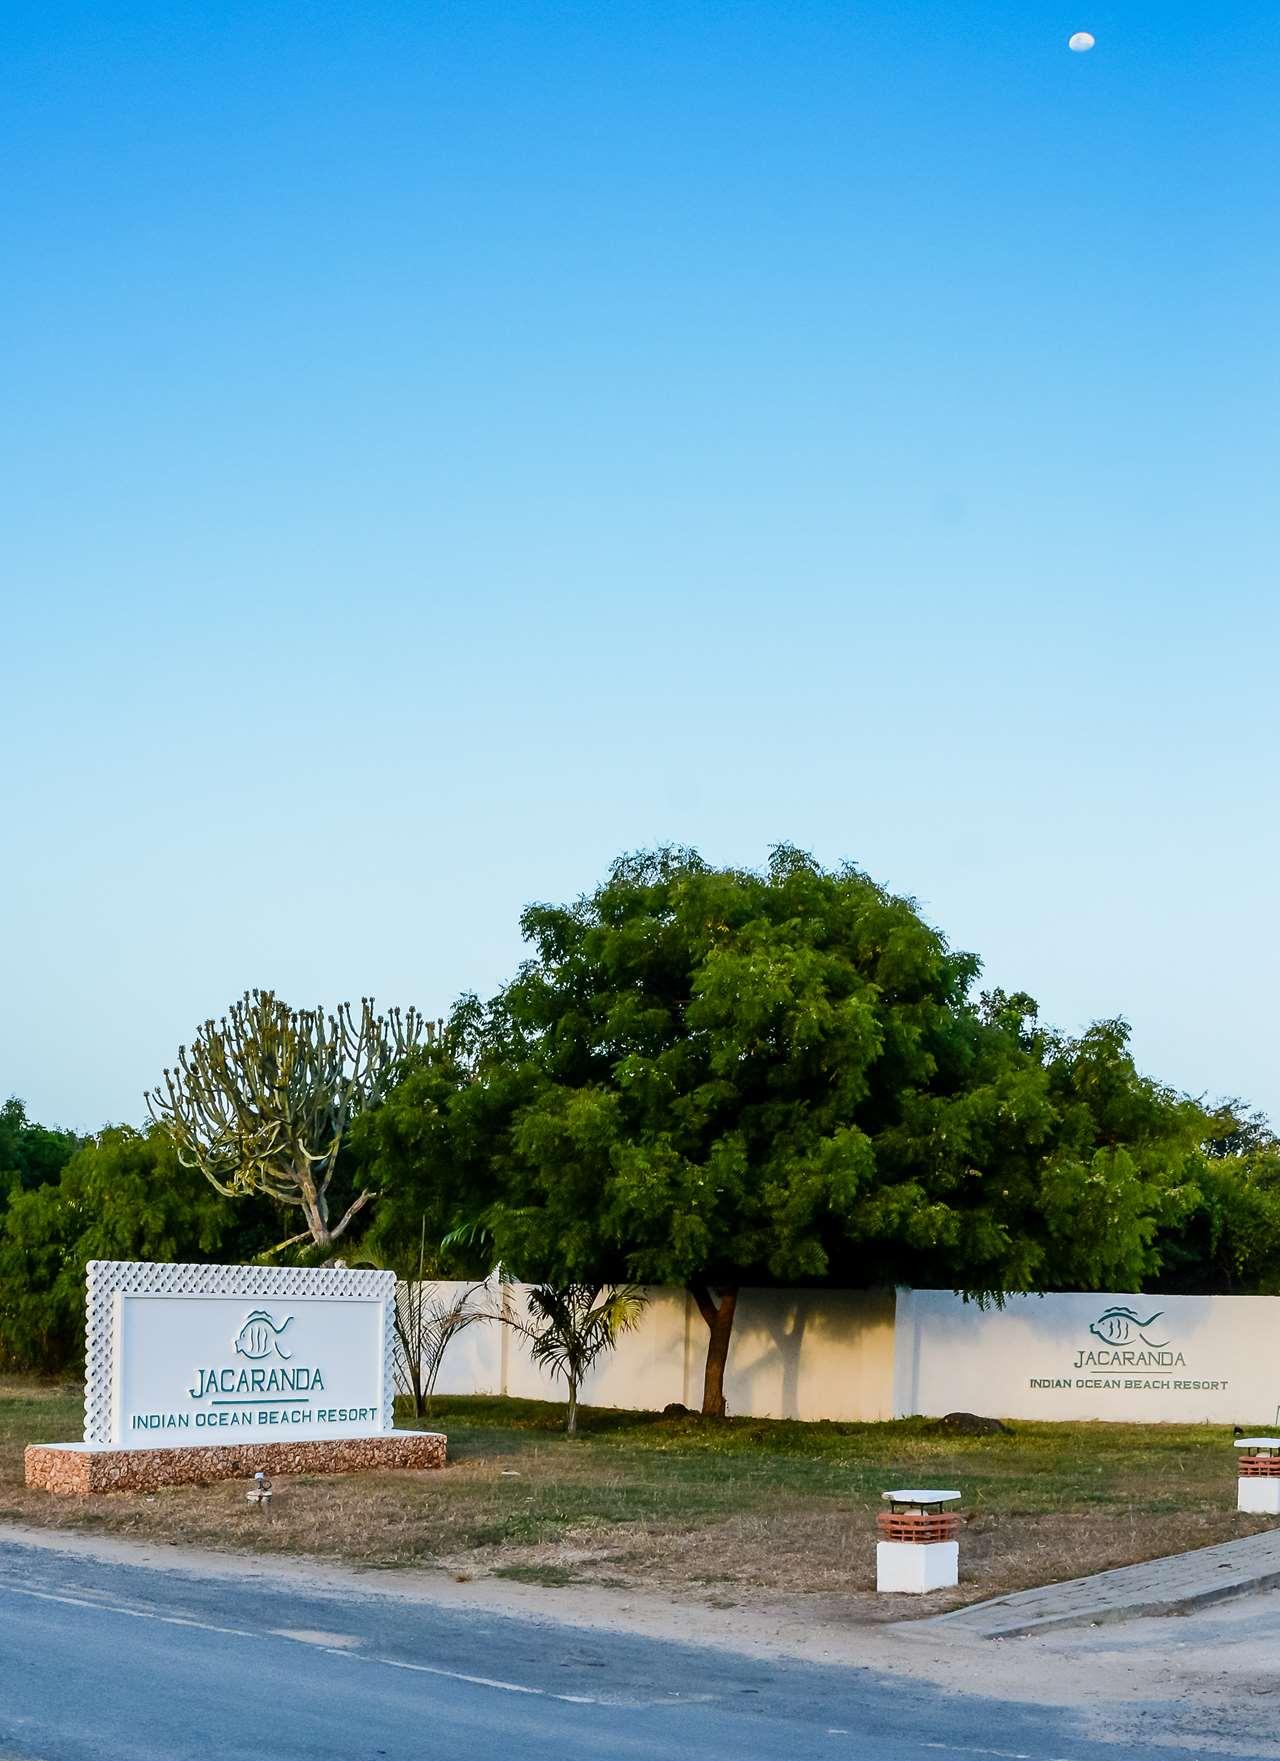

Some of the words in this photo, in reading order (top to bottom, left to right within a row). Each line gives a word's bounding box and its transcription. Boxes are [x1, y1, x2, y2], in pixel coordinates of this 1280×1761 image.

[1074, 1351, 1186, 1368] JACARANDA
[189, 1368, 324, 1398] JACARANDA
[1030, 1379, 1072, 1389] INDIAN
[1076, 1379, 1121, 1389] OCEAN
[1125, 1380, 1170, 1389] BEACH
[1173, 1381, 1229, 1390] RESORT
[132, 1414, 189, 1429] INDIAN
[195, 1411, 251, 1427] OCEAN
[258, 1409, 312, 1424] BEACH
[317, 1407, 378, 1422] RESORT
